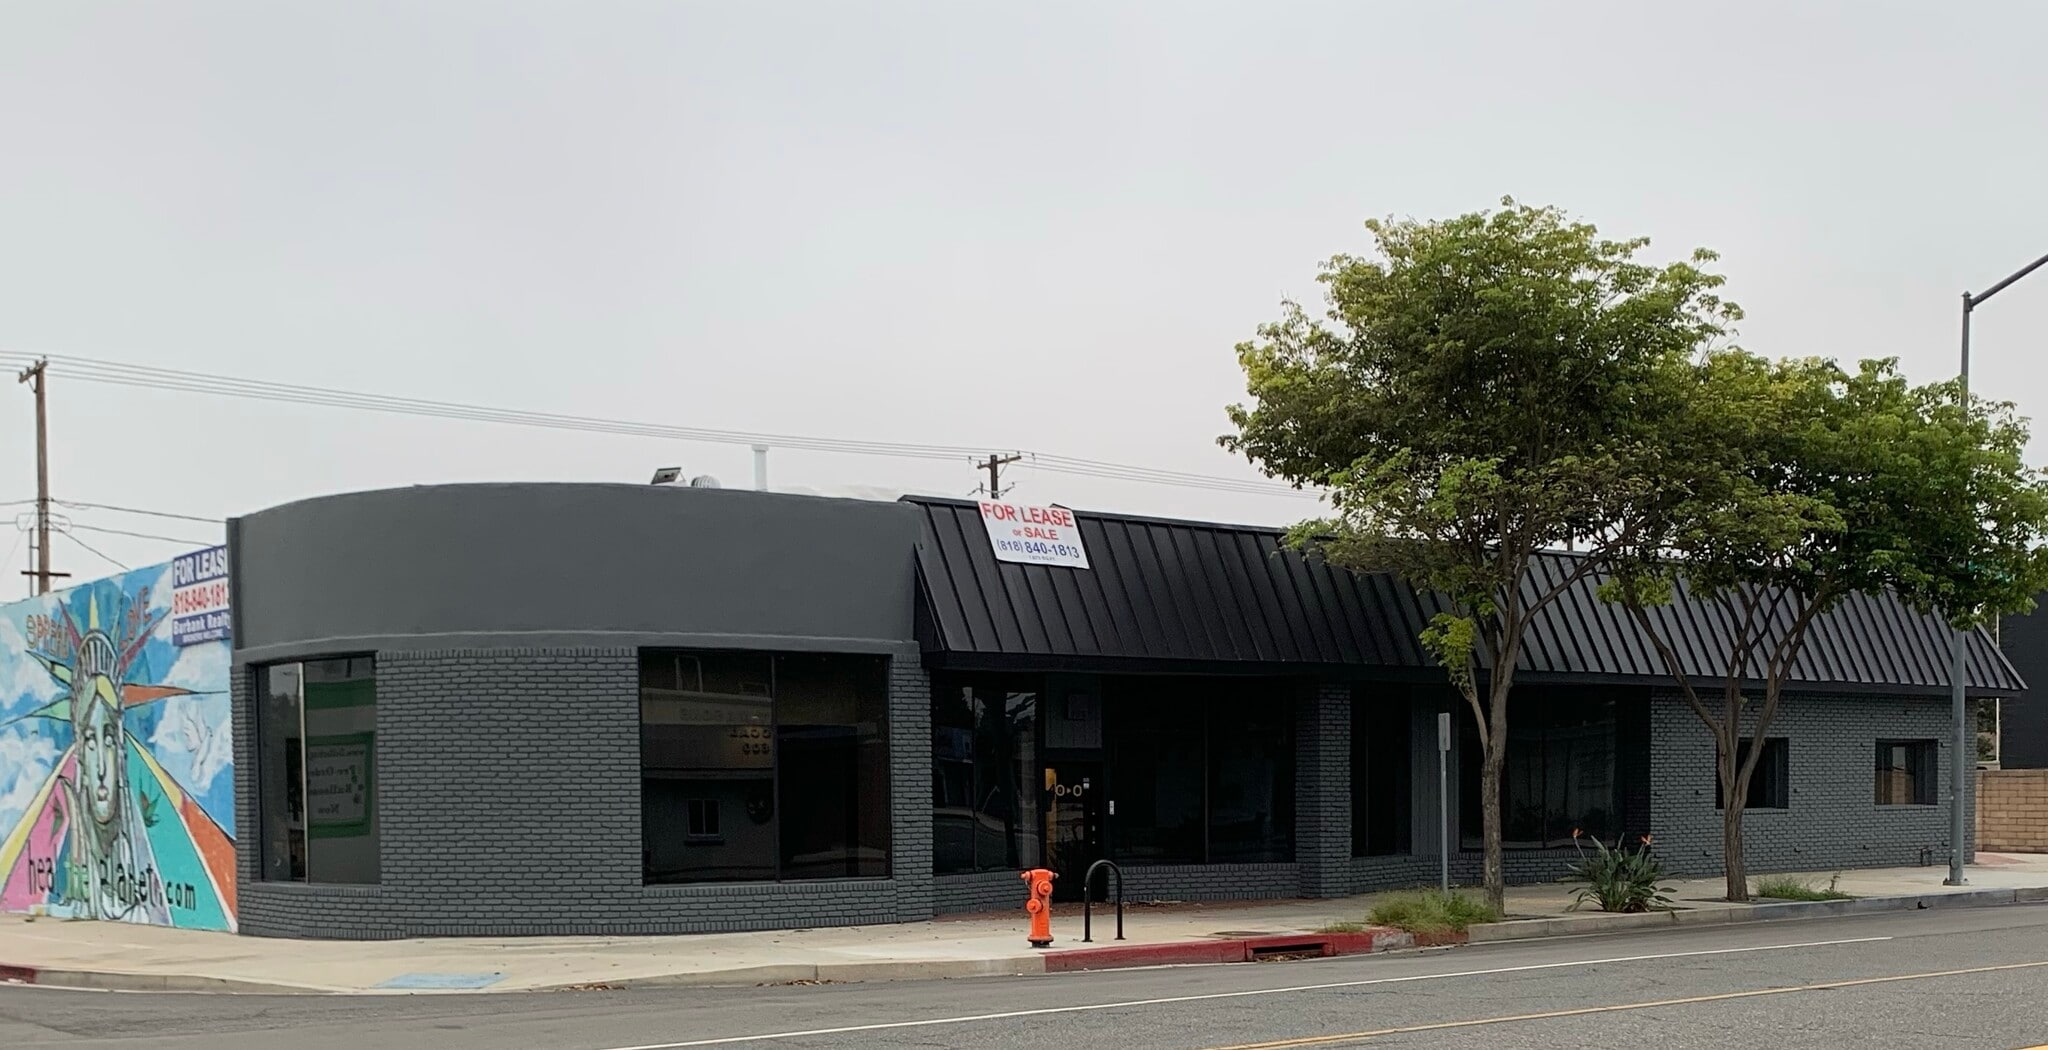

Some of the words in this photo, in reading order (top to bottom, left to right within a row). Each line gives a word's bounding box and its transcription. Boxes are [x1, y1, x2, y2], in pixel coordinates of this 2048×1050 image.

[981, 503, 1018, 522] FOR
[1020, 506, 1074, 528] LEASE
[1012, 528, 1022, 537] or
[1024, 526, 1059, 540] SALE
[996, 538, 1024, 554] (818)
[1025, 541, 1080, 559] 840-1813
[174, 557, 195, 586] FOR
[173, 583, 229, 615] 818-840-181
[173, 615, 207, 636] Burbank
